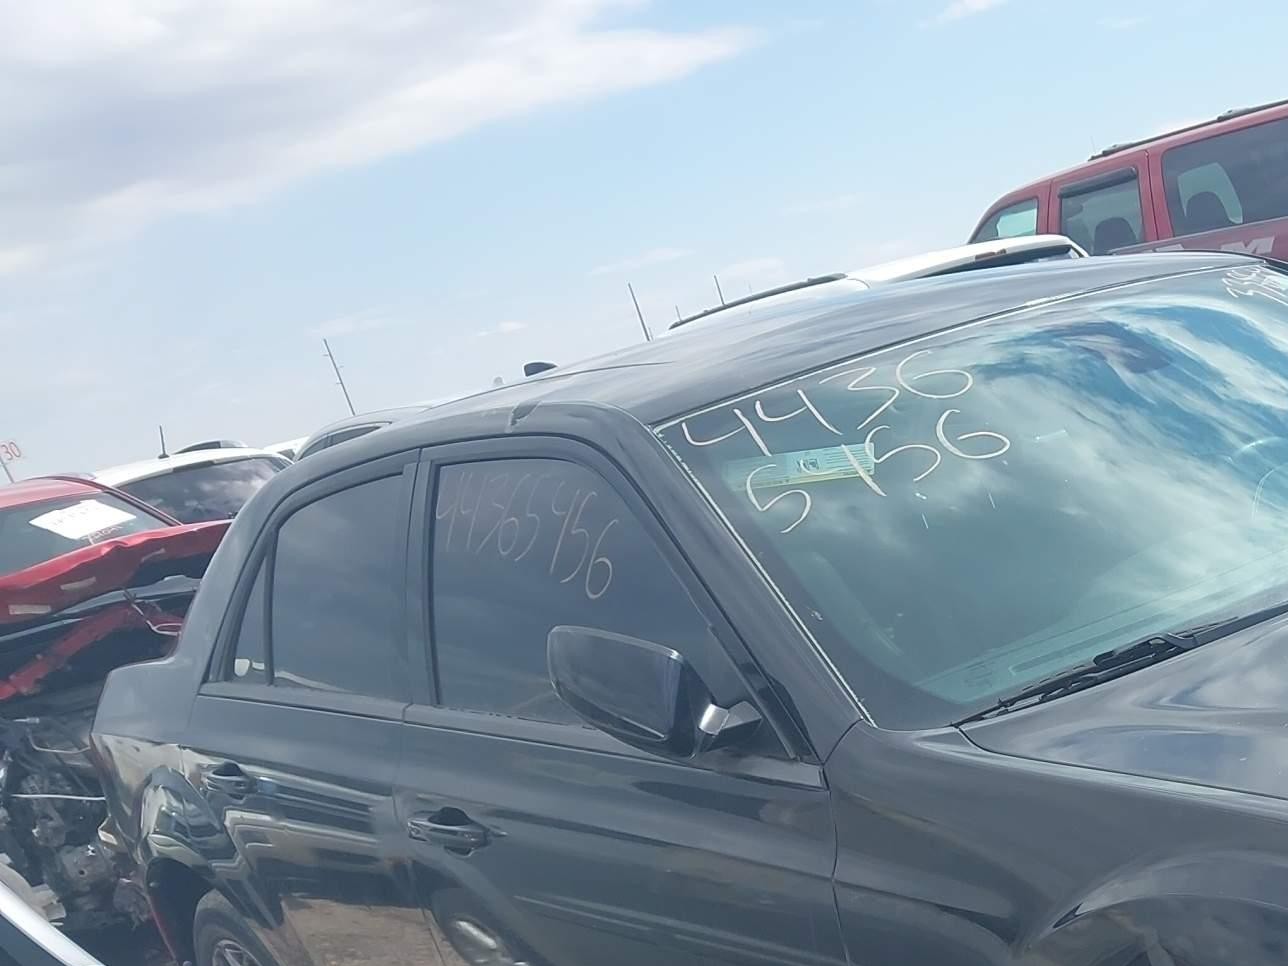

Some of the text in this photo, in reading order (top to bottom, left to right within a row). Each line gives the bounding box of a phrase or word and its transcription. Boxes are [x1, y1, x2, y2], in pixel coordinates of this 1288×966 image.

[682, 350, 973, 457] 4436
[746, 408, 1011, 534] 5456
[435, 471, 620, 600] 44365456
